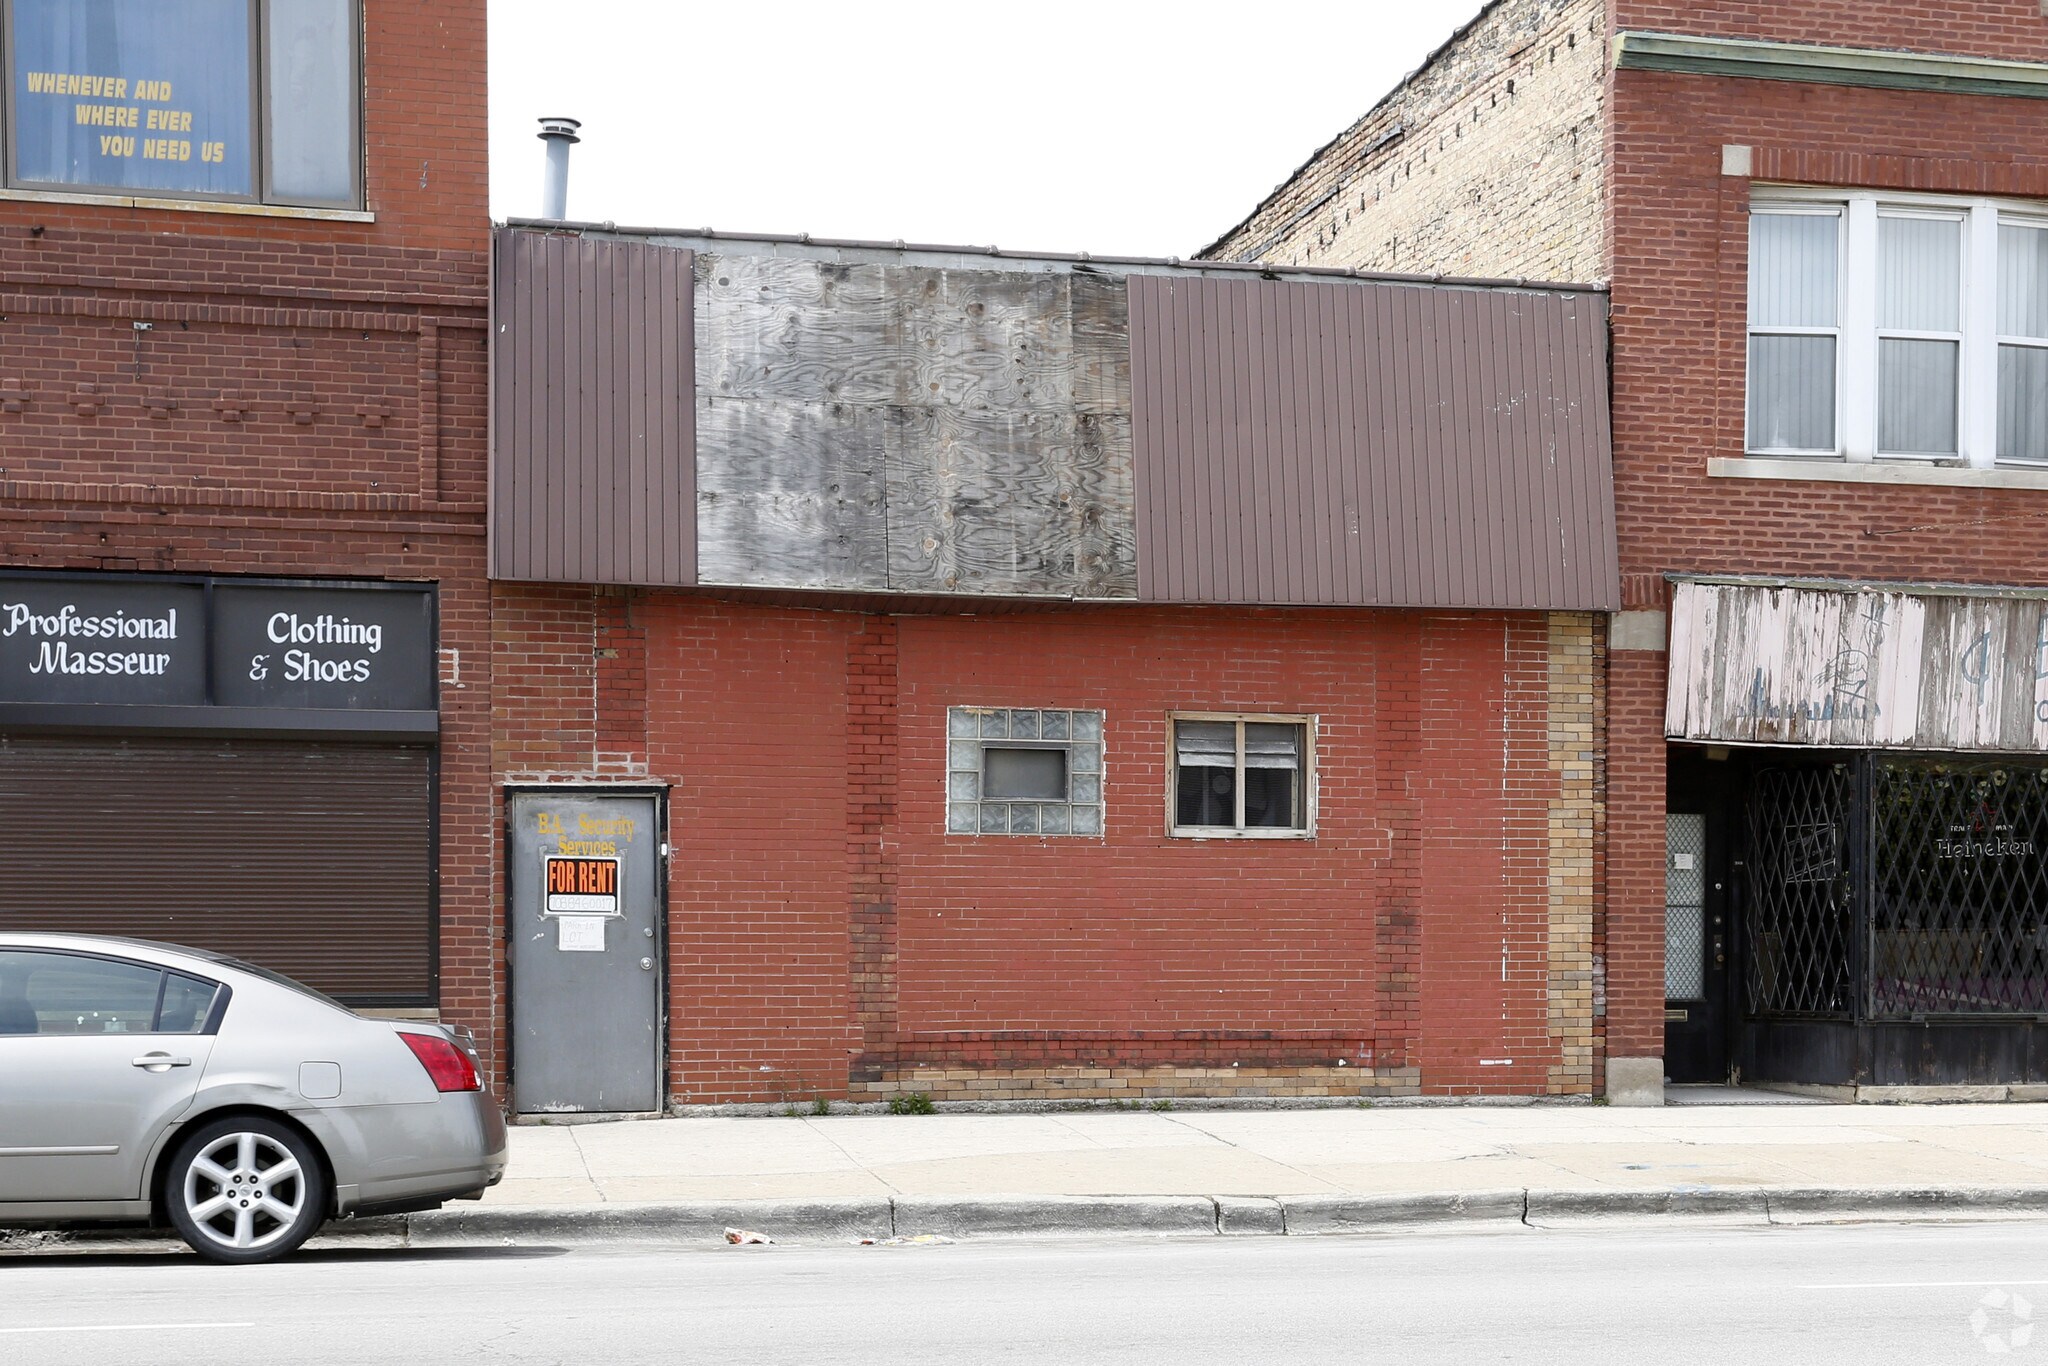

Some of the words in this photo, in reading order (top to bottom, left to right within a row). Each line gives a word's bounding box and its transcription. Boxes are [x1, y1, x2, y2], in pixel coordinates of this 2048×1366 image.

[27, 72, 127, 99] WHENEVER
[134, 80, 172, 101] AND
[76, 104, 139, 128] WHERE
[146, 109, 193, 132] EVER
[100, 135, 135, 157] YOU
[143, 139, 190, 161] NEED
[201, 142, 225, 163] US
[2, 602, 178, 640] Professional
[267, 612, 382, 654] Clothing
[29, 641, 171, 675] Masseur
[249, 654, 270, 681] &
[284, 649, 371, 682] Shoes
[578, 812, 635, 842] Security
[558, 835, 616, 856] Services
[1935, 836, 2035, 859] Heineken
[549, 860, 575, 893] FOR
[578, 861, 616, 894] RENT
